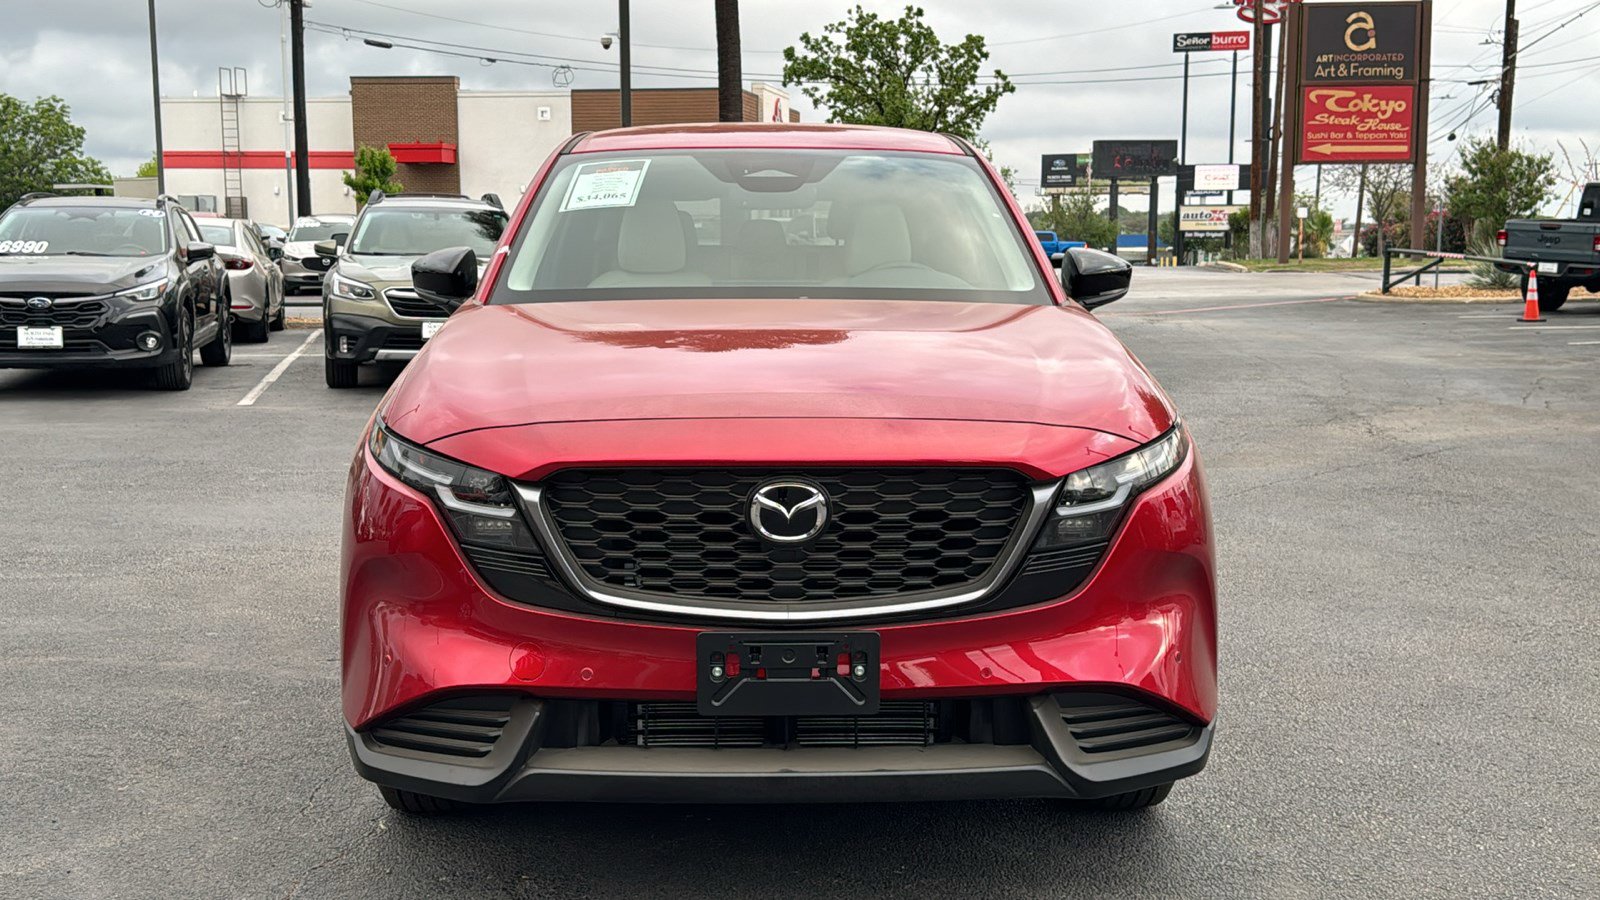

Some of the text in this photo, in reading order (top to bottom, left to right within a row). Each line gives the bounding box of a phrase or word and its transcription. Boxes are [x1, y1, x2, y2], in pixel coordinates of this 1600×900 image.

[1176, 34, 1247, 47] Señor burro
[1314, 63, 1404, 79] Art & Framing
[1309, 89, 1407, 119] Tokyo
[1307, 113, 1409, 131] Steak House
[1307, 132, 1328, 140] Sushi
[1355, 132, 1388, 140] Teppan
[1537, 234, 1561, 245] Jeep
[0, 240, 49, 254] 6990
